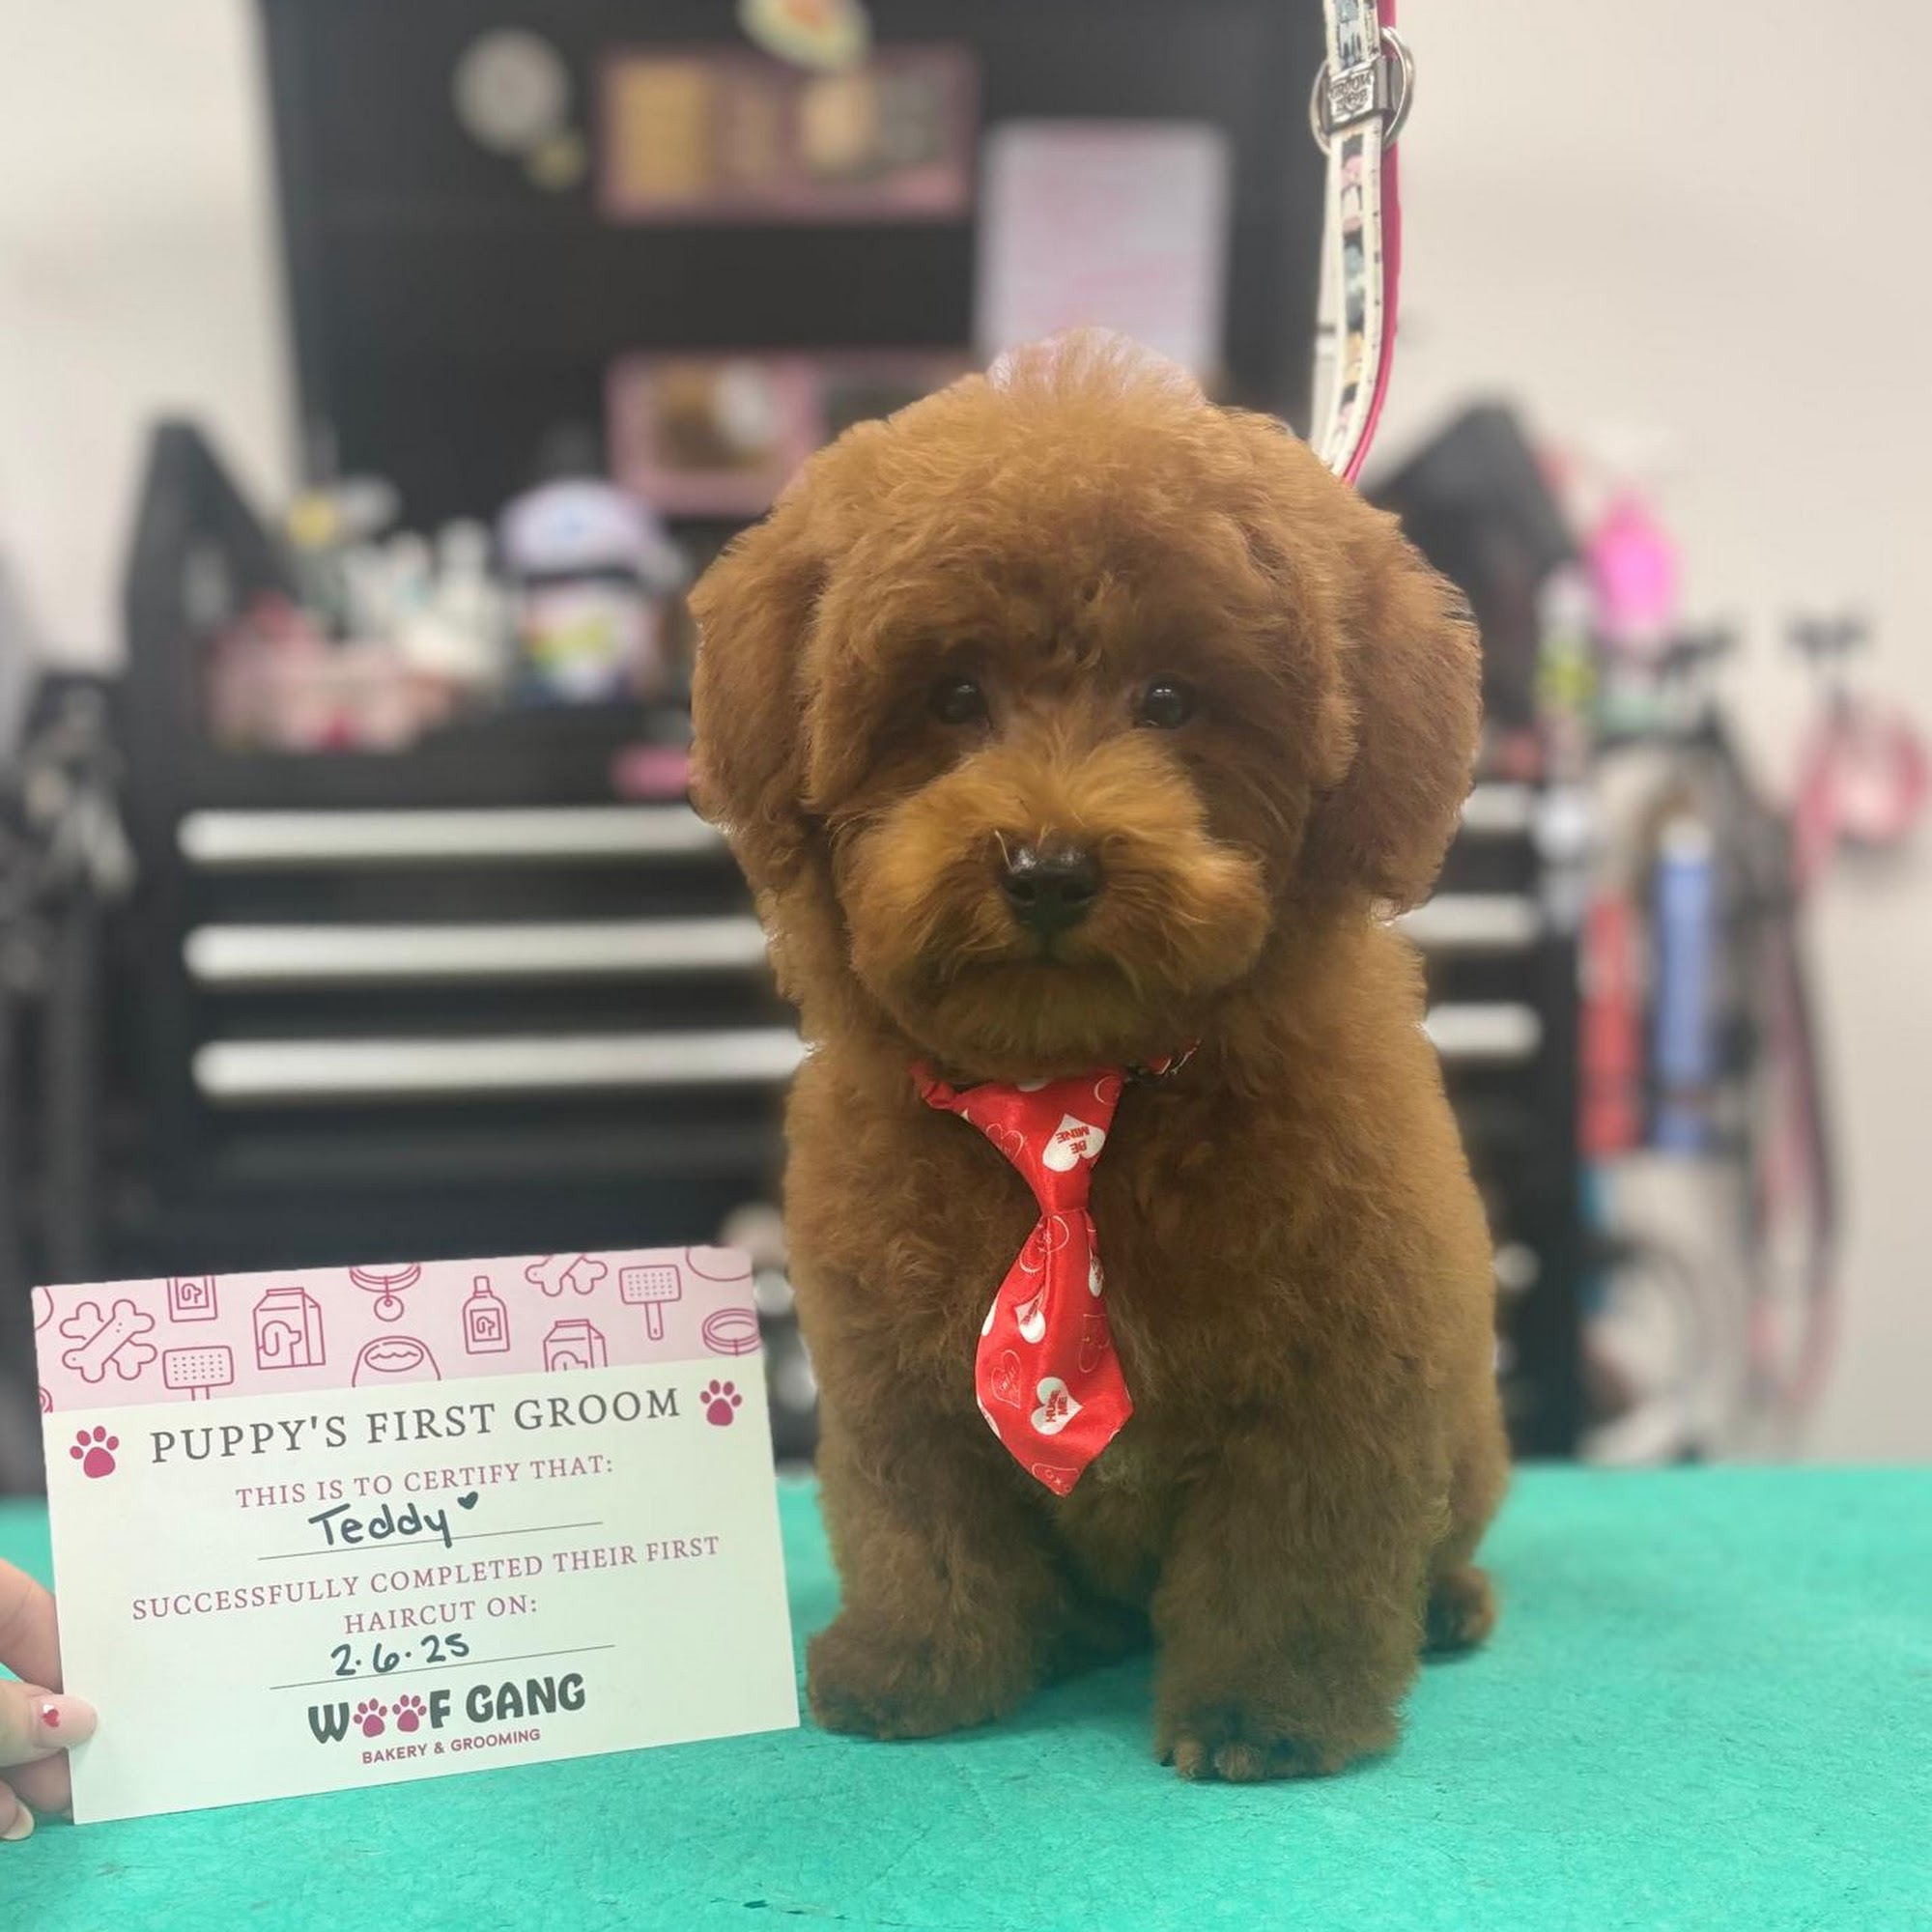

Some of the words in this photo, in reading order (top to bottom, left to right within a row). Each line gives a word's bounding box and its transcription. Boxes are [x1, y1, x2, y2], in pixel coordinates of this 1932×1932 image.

[1055, 1125, 1090, 1144] MINE
[1068, 1140, 1087, 1154] BE
[150, 1416, 347, 1463] PUPPY'S
[366, 1404, 495, 1443] FIRST
[514, 1388, 680, 1430] GROOM
[236, 1483, 305, 1508] THIS
[318, 1479, 343, 1500] IS
[354, 1475, 392, 1496] TO
[404, 1463, 520, 1492] CERTIFY
[530, 1455, 612, 1479] THAT:
[308, 1502, 452, 1548] Teddy
[132, 1577, 358, 1620] SUCCESSFULLY
[371, 1555, 543, 1593] COMPLETED
[553, 1546, 637, 1573] THEIR
[646, 1536, 719, 1562] FIRST
[344, 1601, 476, 1634] HAIRCUT
[487, 1595, 536, 1617] ON:
[466, 1672, 585, 1723] GANG
[362, 1743, 428, 1764] BAKERY
[434, 1742, 444, 1754] &
[451, 1728, 541, 1752] GROOMING
